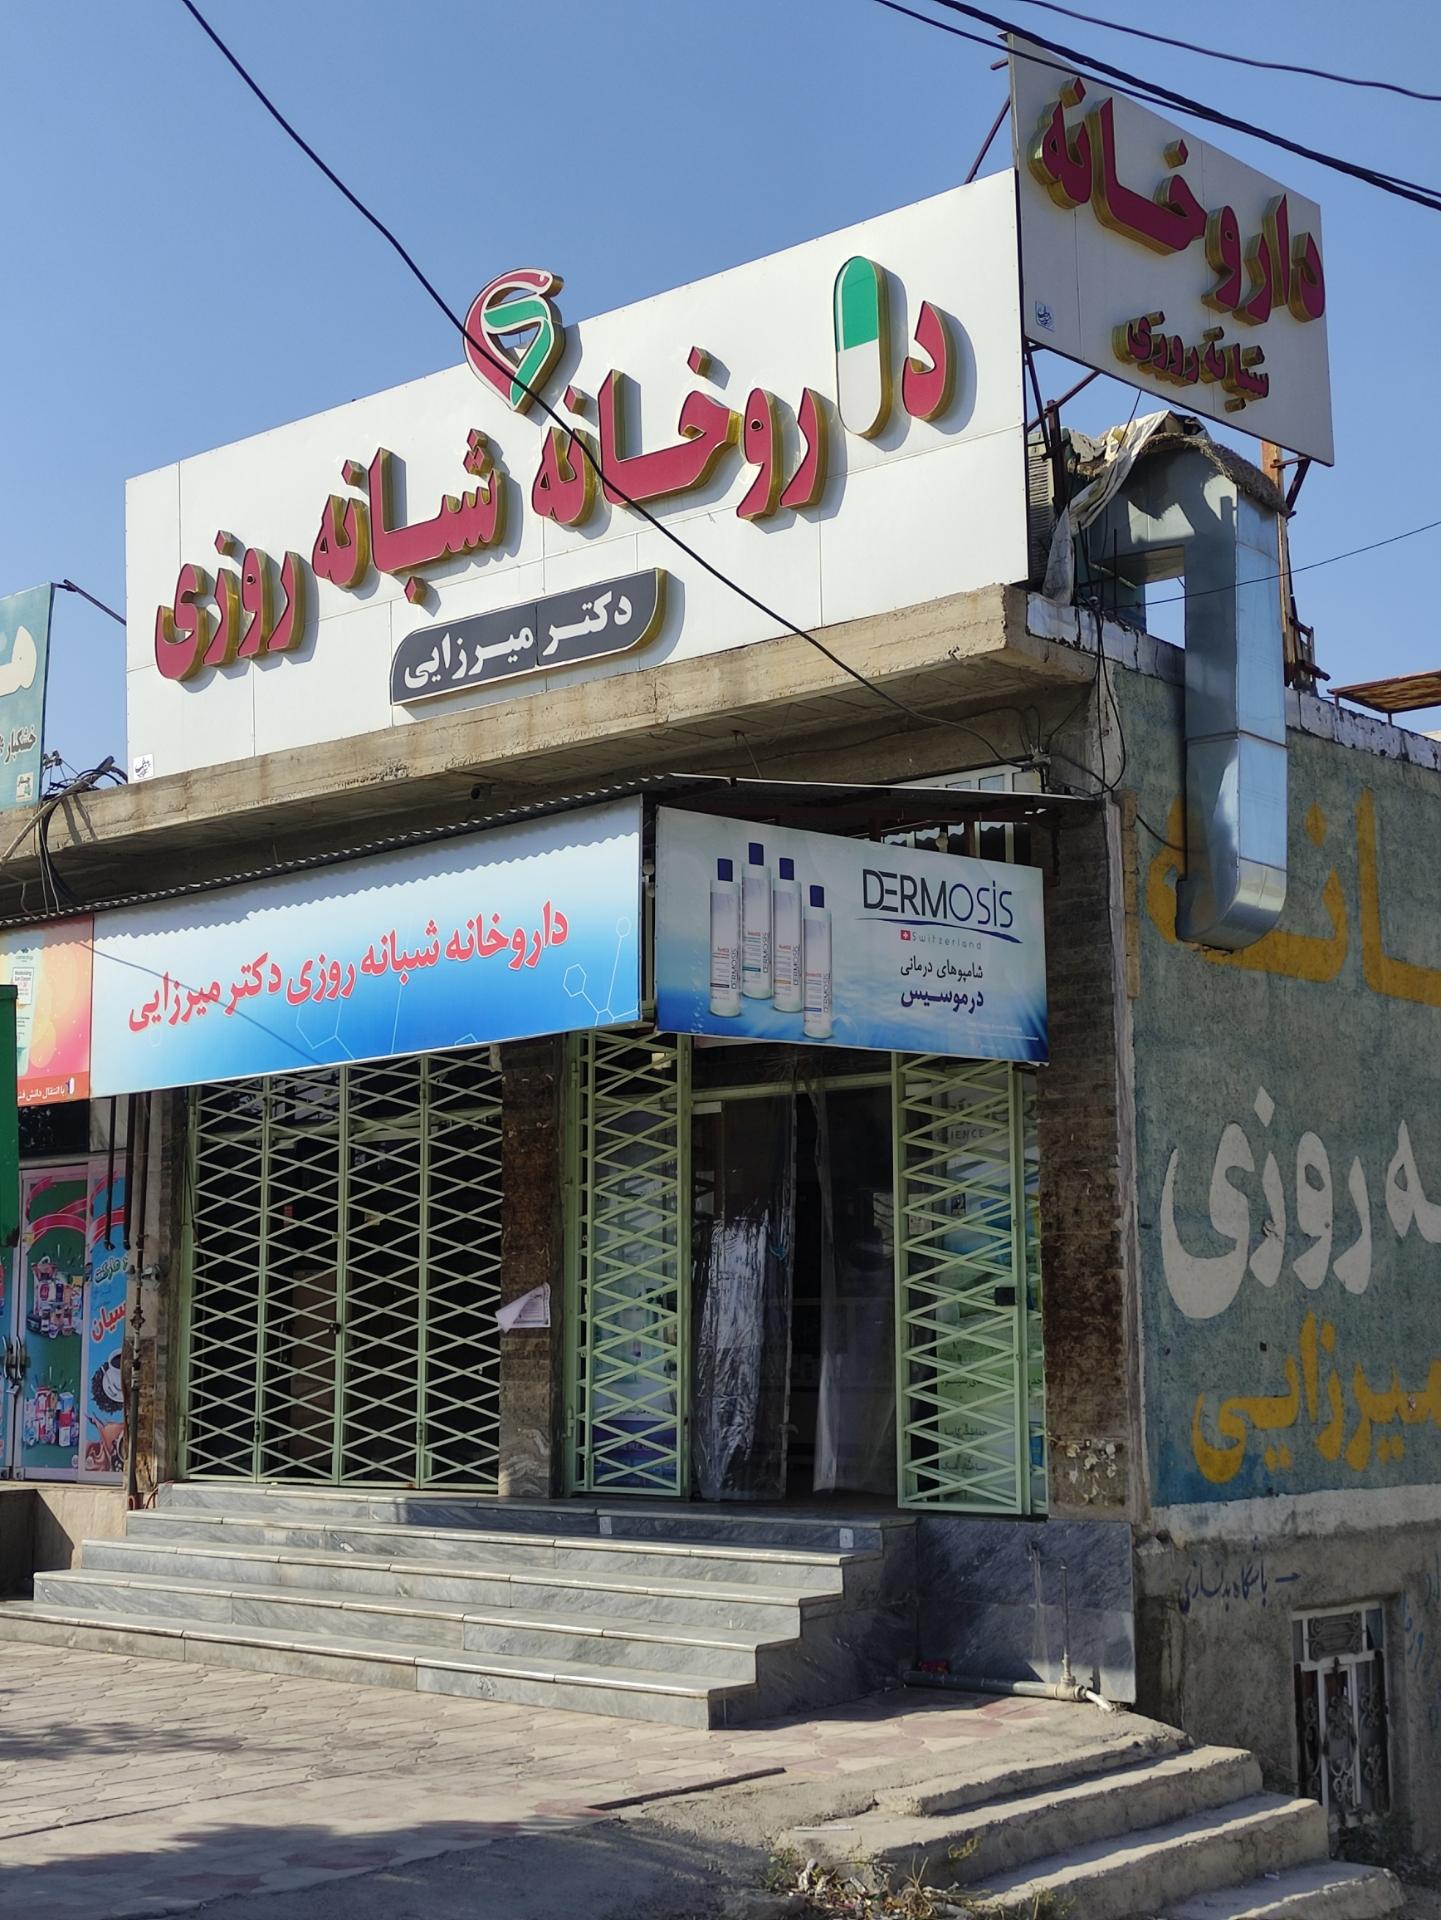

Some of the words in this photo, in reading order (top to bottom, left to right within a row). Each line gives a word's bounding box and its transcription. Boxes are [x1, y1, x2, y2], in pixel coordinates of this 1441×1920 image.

[1028, 77, 1325, 325] داروخانه
[1112, 311, 1198, 387] روزی
[1199, 326, 1269, 412] شبانه
[531, 255, 957, 527] داروخانه
[312, 428, 510, 607] شبانه
[155, 529, 306, 681] روزی
[543, 589, 632, 656] دکتر
[404, 626, 534, 689] میرزایی
[361, 919, 440, 985] شبانه
[445, 900, 569, 971] داروخانه
[900, 955, 933, 978] درمانی
[912, 932, 982, 950] Switzerland
[129, 972, 220, 1033] میرزایی
[224, 953, 281, 1015] دکتر
[286, 955, 356, 1006] روزی
[900, 988, 985, 1015] درموسیس
[937, 959, 984, 982] شامپوهای
[1160, 1085, 1372, 1319] روزی
